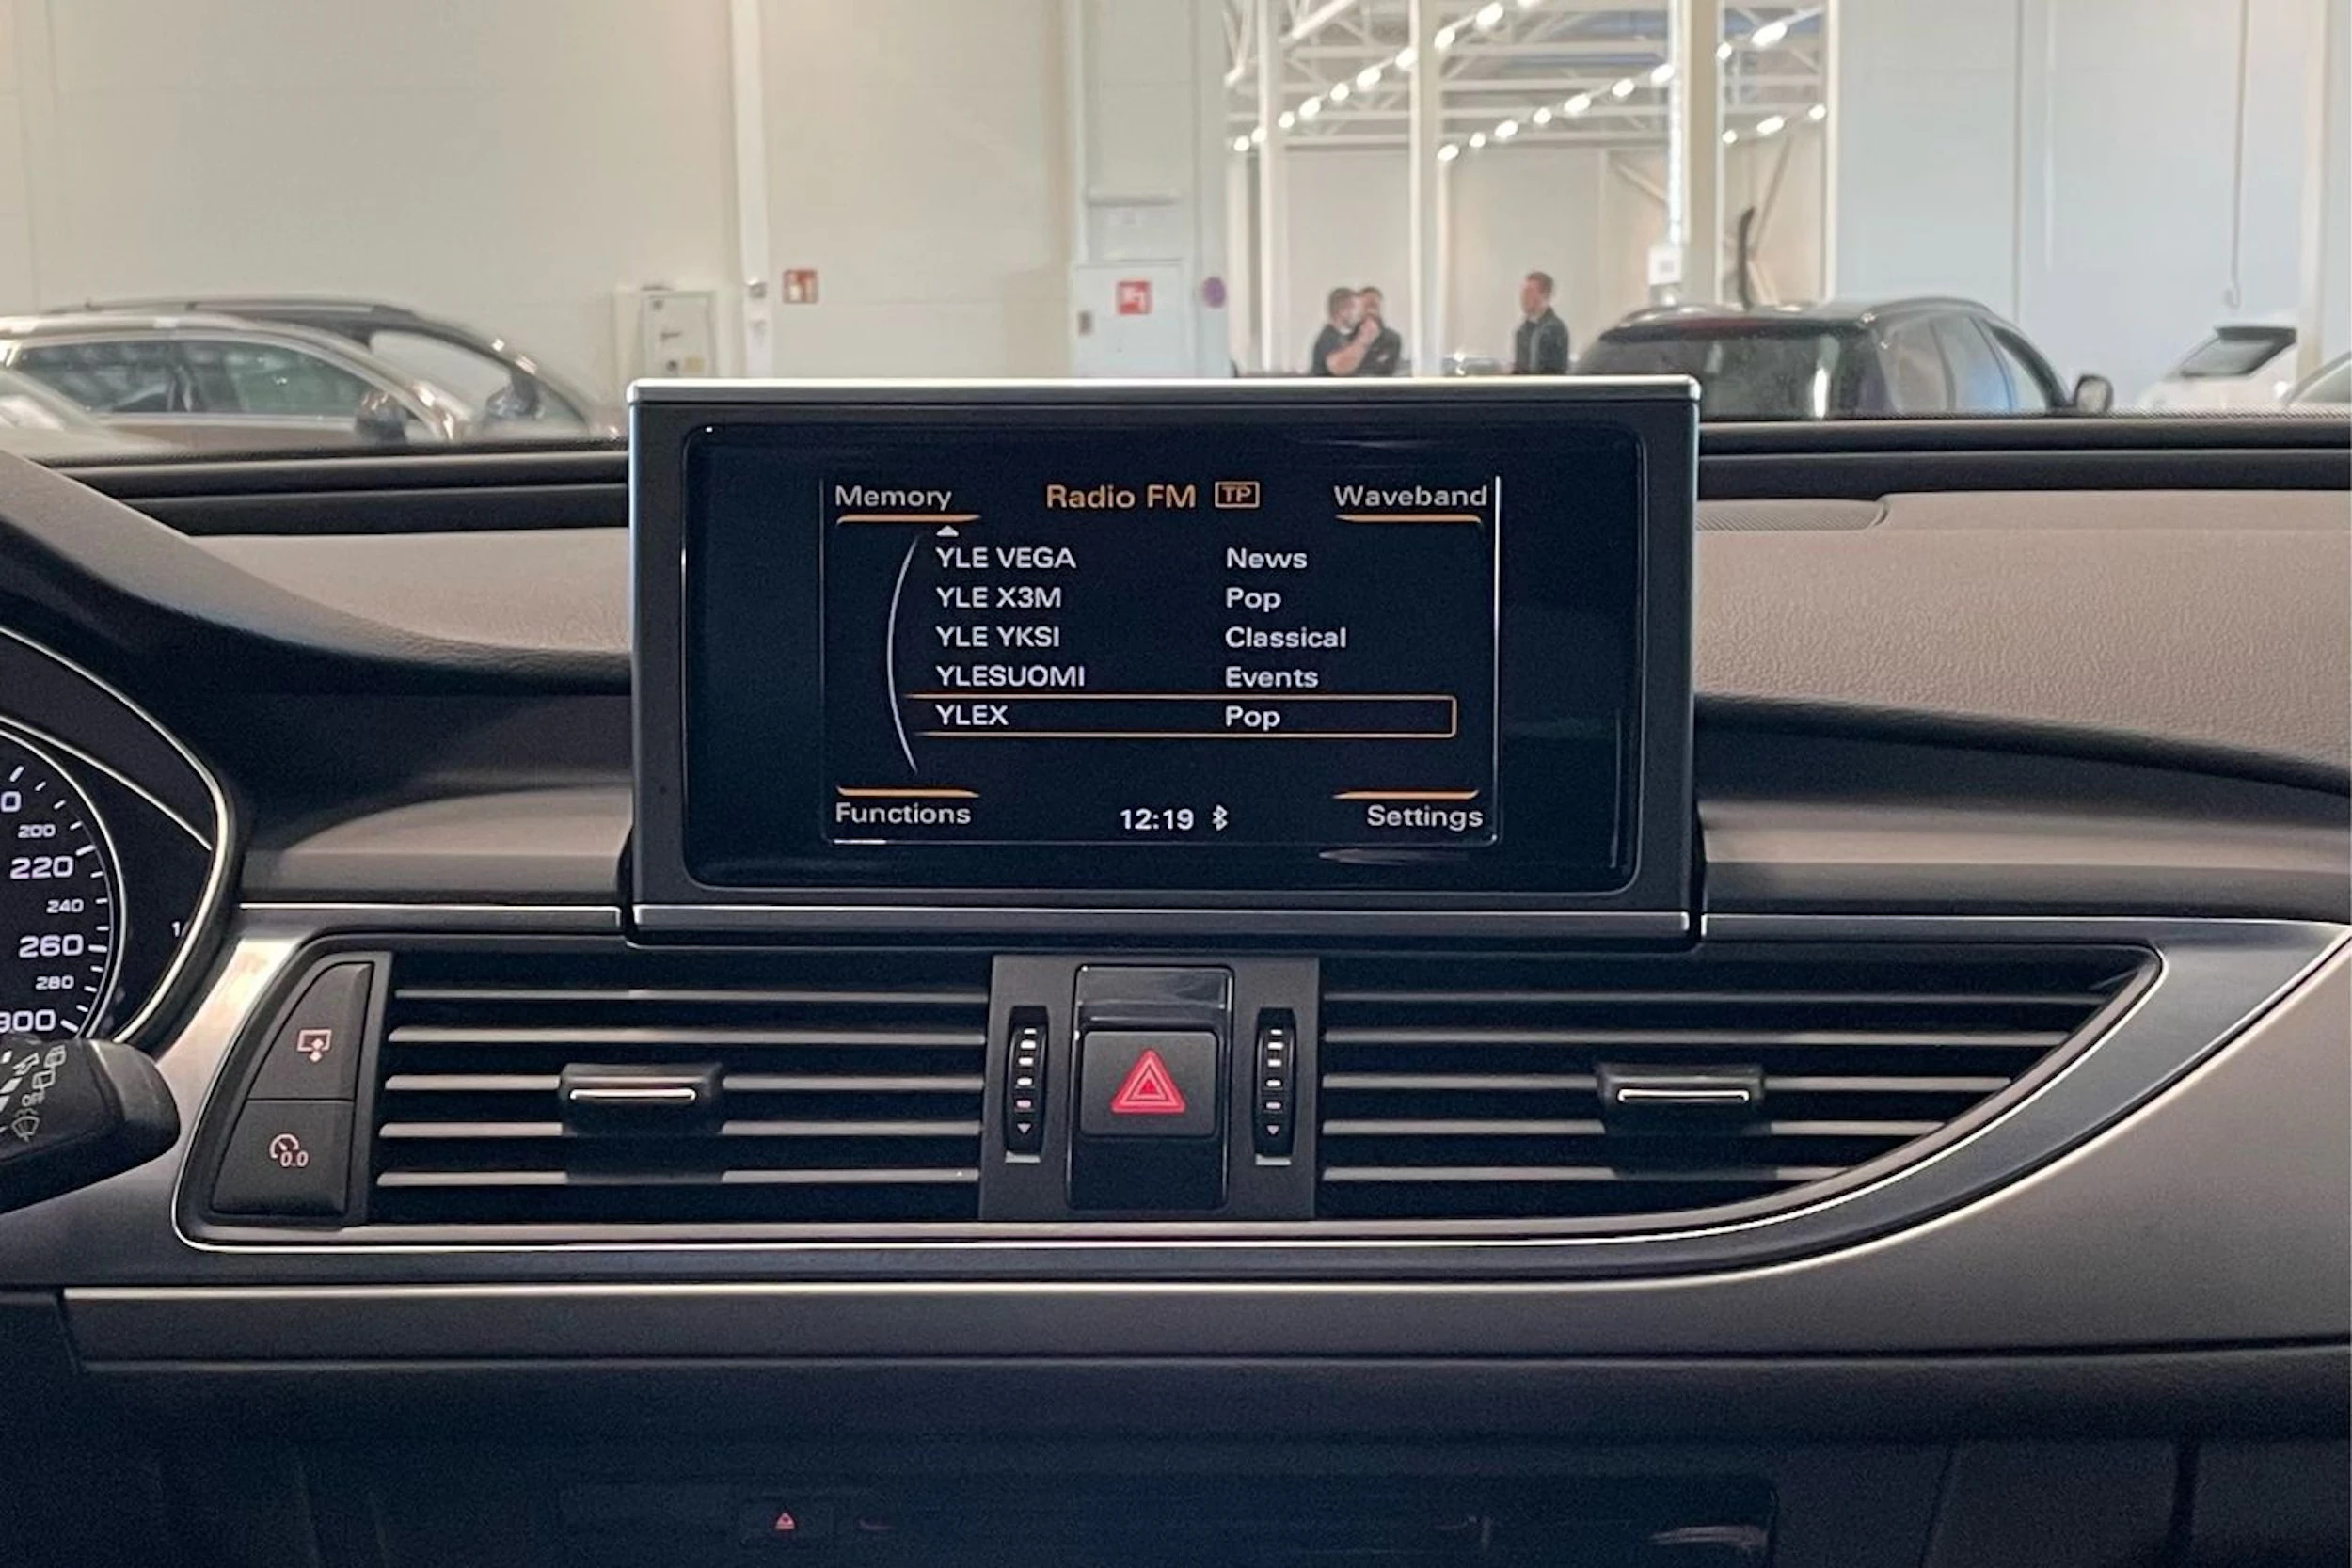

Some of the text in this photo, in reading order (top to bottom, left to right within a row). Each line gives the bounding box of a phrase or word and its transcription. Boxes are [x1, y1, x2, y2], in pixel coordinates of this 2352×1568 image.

[834, 484, 952, 512] Memory
[1046, 484, 1252, 509] Radio FM TP
[1333, 484, 1487, 507] Waveband
[936, 546, 1077, 569] YLE VEGA
[1226, 547, 1308, 569] News
[936, 586, 1062, 609] YLE X3M
[1226, 587, 1282, 613] Pop
[936, 626, 1060, 648] YLE YKSI
[1225, 626, 1346, 648] Classical
[936, 664, 1085, 688] YLESUOMI
[1225, 665, 1319, 689] Events
[936, 704, 1009, 726] YLEX
[1225, 705, 1281, 730] Pop
[835, 801, 972, 825] Functions
[1120, 808, 1194, 831] 12:19
[1367, 804, 1484, 832] Settings
[17, 823, 56, 839] 200
[9, 855, 74, 879] 220
[46, 898, 85, 914] 240
[18, 933, 84, 958] 260
[35, 974, 75, 990] 280
[280, 1150, 309, 1167] 0.0
